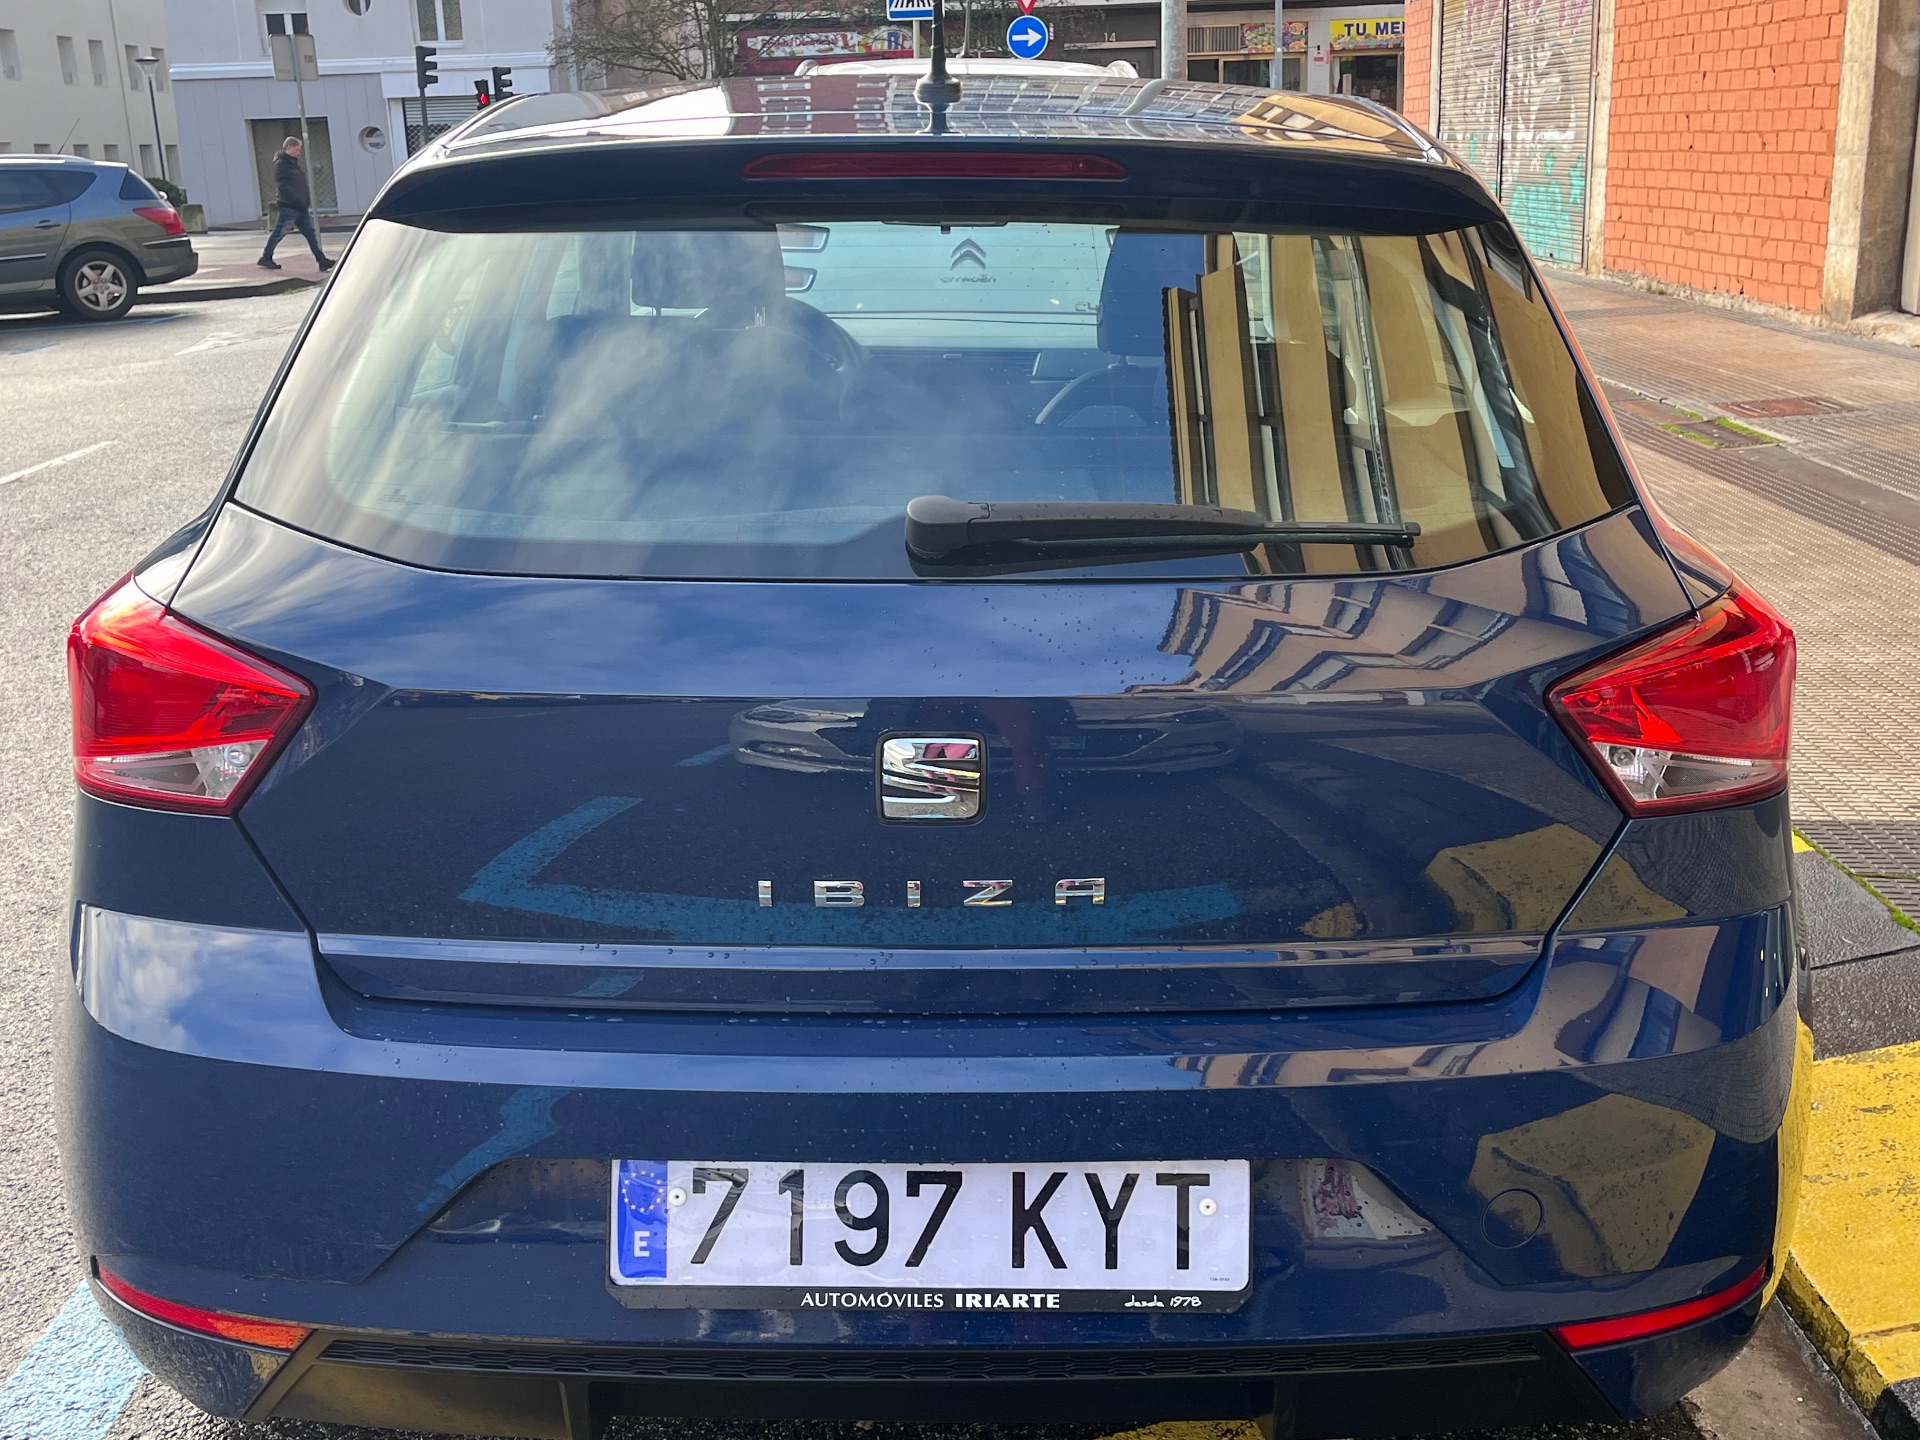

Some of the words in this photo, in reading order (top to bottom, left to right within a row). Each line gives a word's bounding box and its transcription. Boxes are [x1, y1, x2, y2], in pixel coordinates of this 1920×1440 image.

[1103, 32, 1117, 42] 14
[1344, 23, 1367, 36] TU
[757, 877, 1105, 907] IBIZA
[690, 1168, 963, 1268] 7197
[1011, 1171, 1211, 1270] KYT
[633, 1230, 650, 1257] E
[800, 1291, 944, 1309] AUTOMÓVILES
[955, 1293, 1060, 1308] IRIARTE
[1124, 1294, 1165, 1308] desde
[1169, 1296, 1202, 1308] 1978
